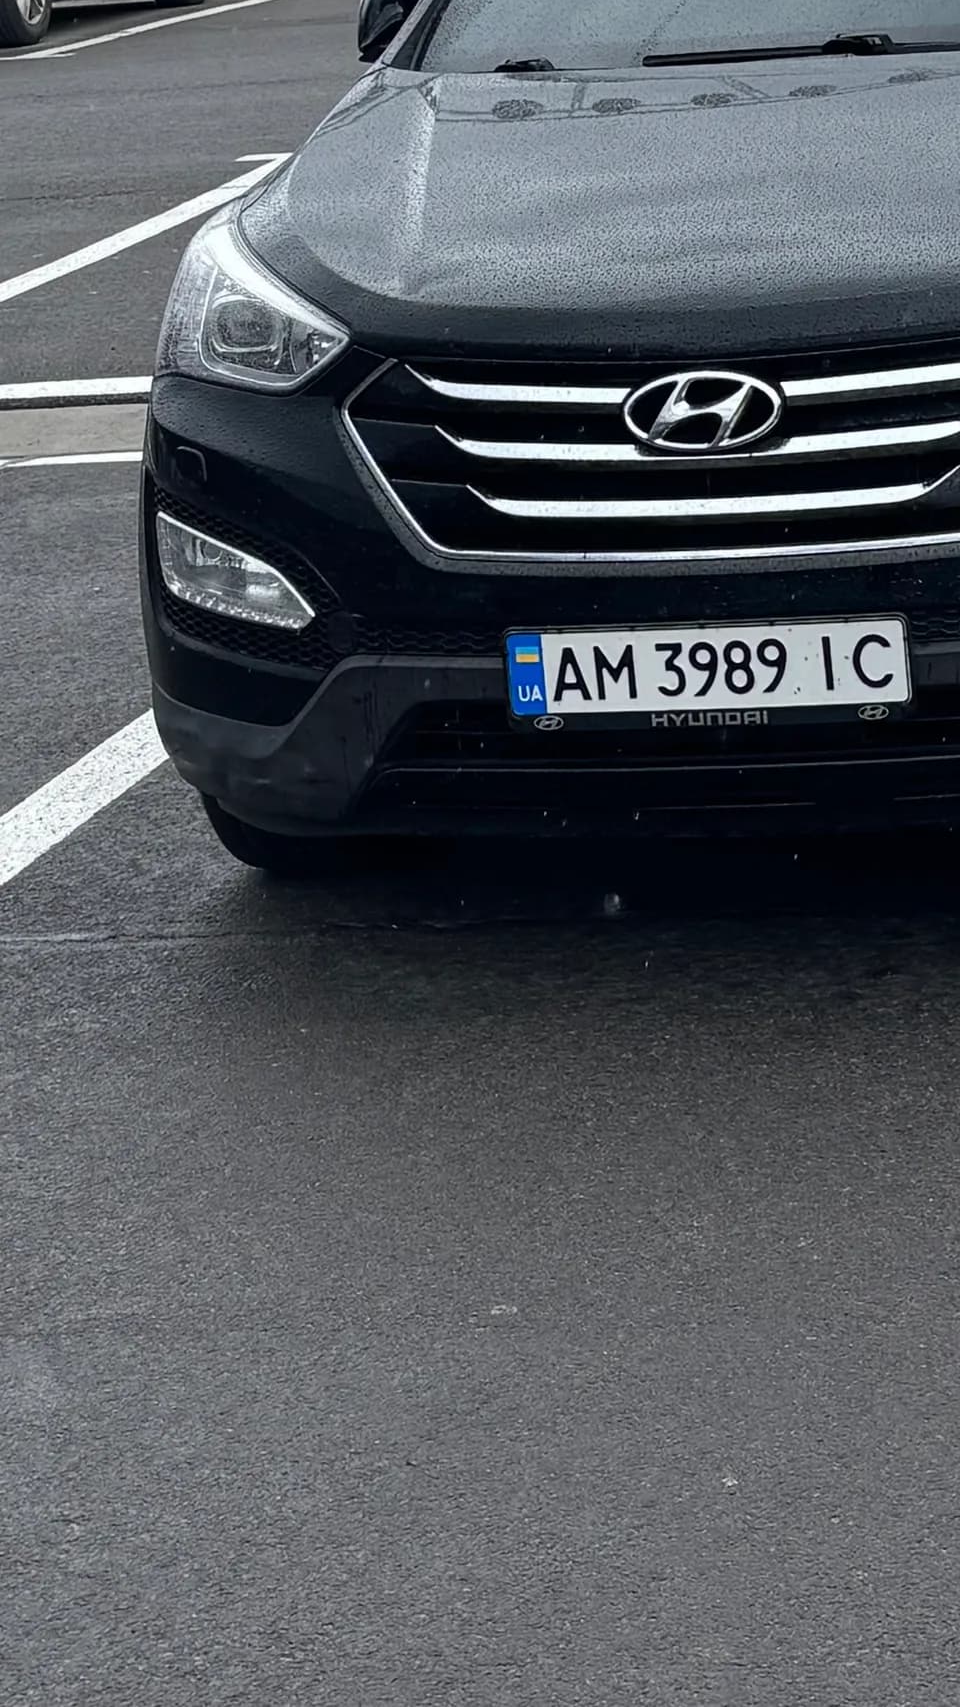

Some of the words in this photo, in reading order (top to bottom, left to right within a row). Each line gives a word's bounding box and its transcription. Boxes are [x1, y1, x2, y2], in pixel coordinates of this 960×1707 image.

[552, 644, 638, 703] AM
[654, 638, 788, 698] 3989
[821, 633, 894, 692] IC
[517, 684, 544, 703] UA
[651, 710, 769, 728] HYUNDAI
